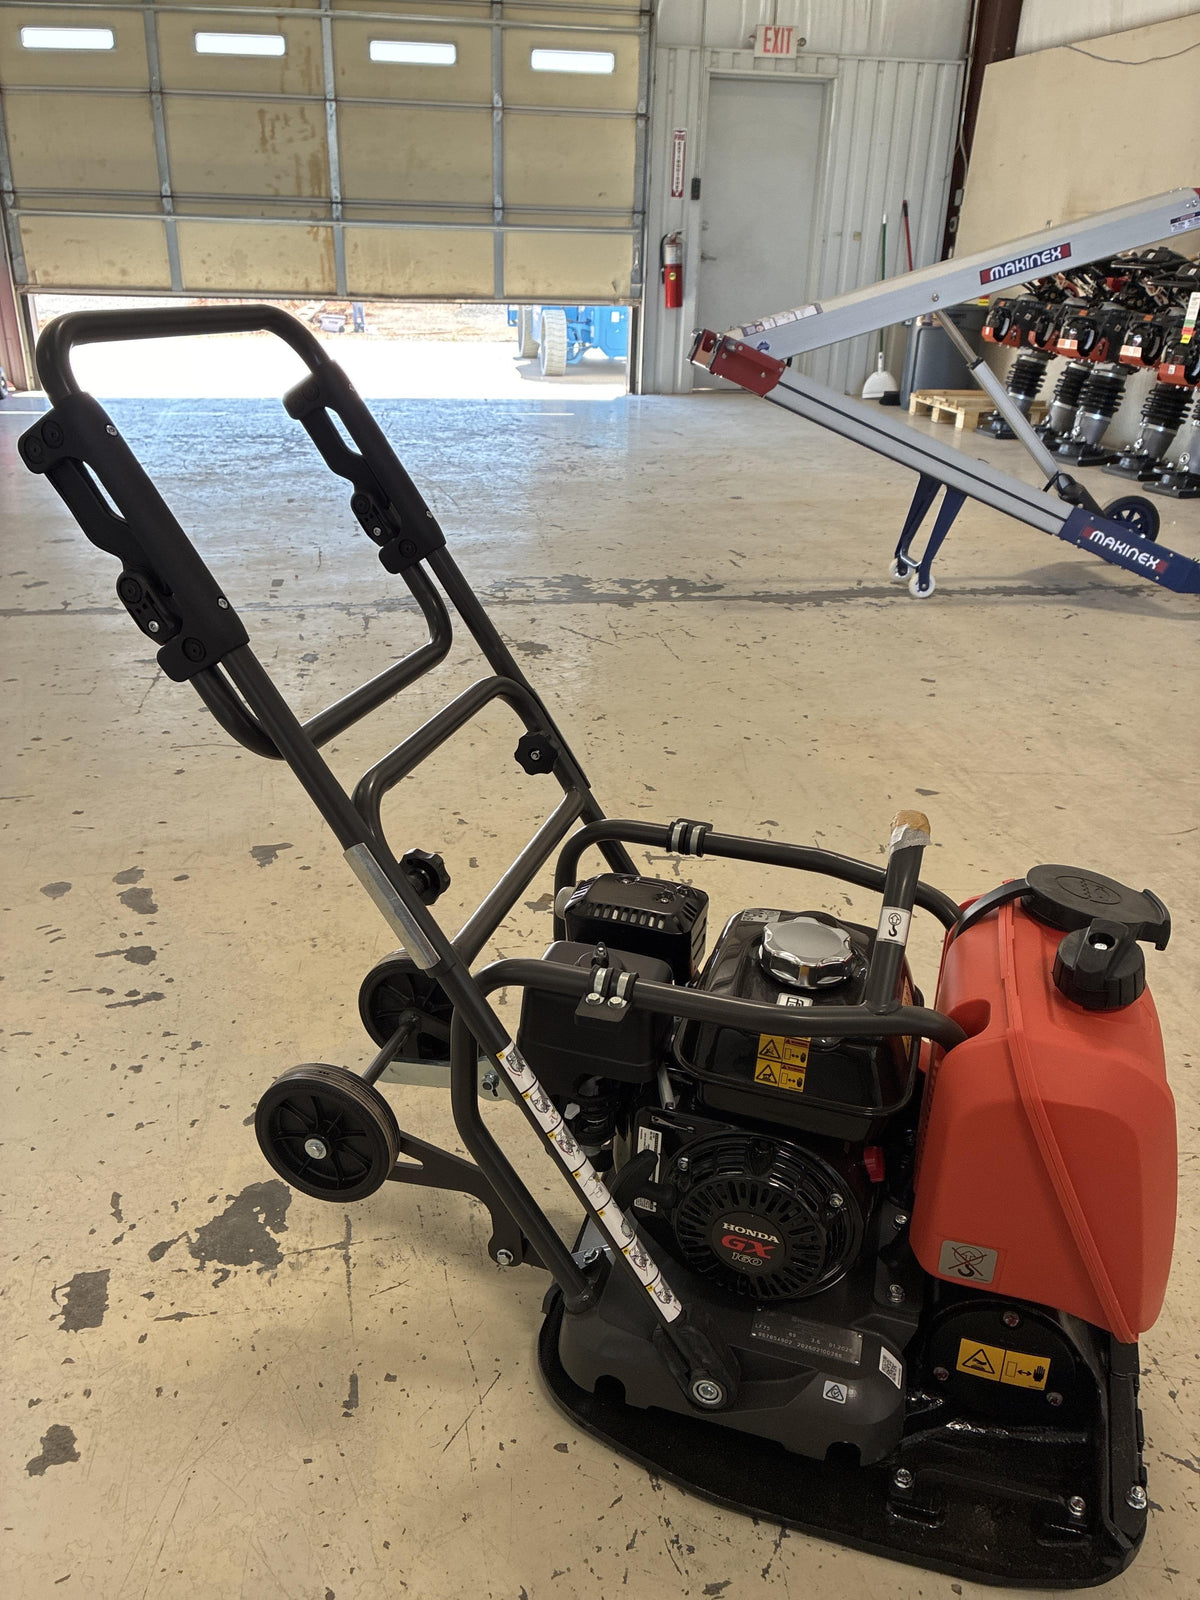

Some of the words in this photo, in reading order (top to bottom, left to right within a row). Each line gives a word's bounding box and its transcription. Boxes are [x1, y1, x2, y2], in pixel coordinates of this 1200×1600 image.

[763, 26, 793, 54] EXIT
[990, 246, 1062, 281] MAKINEX
[1089, 530, 1160, 570] MAKINEX
[722, 1222, 780, 1244] HONDA
[721, 1235, 775, 1259] GX
[731, 1252, 763, 1266] 160
